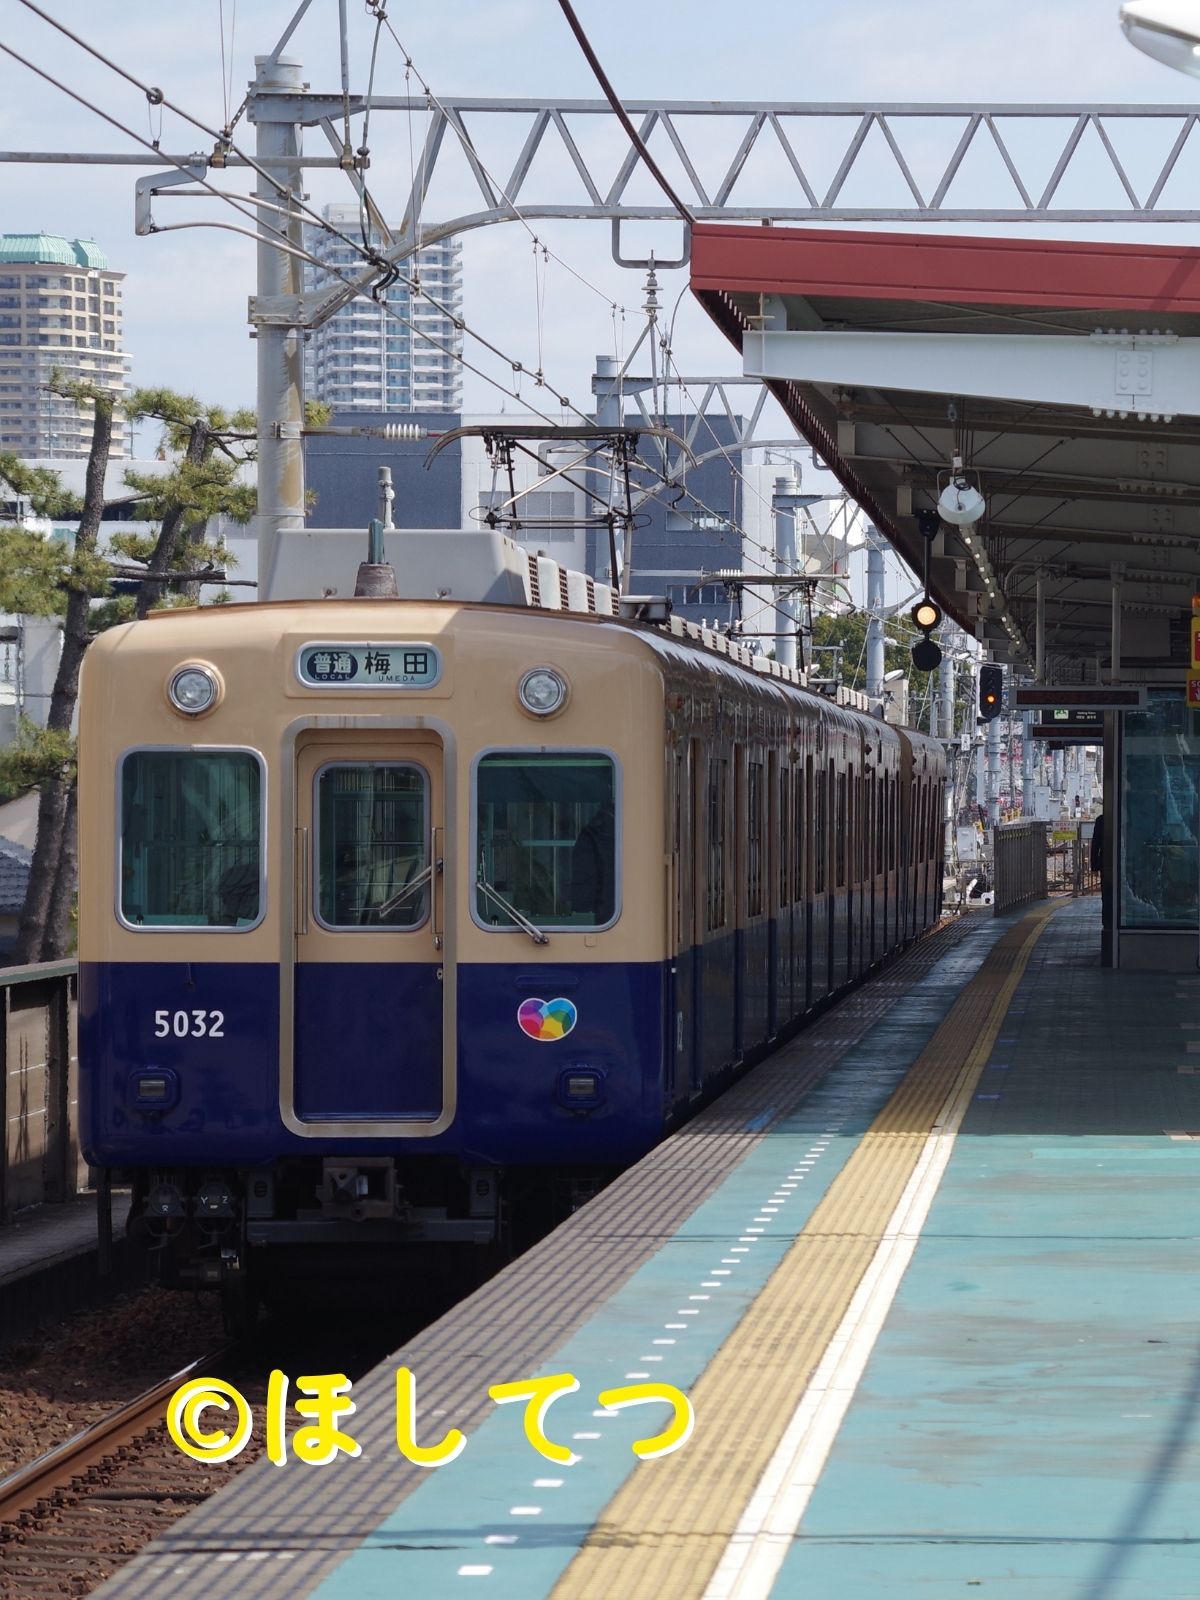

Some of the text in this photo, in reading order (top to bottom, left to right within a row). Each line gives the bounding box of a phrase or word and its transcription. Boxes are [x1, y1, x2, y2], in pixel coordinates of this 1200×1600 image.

[313, 650, 428, 675] 普通 梅田
[154, 1009, 225, 1038] 5032
